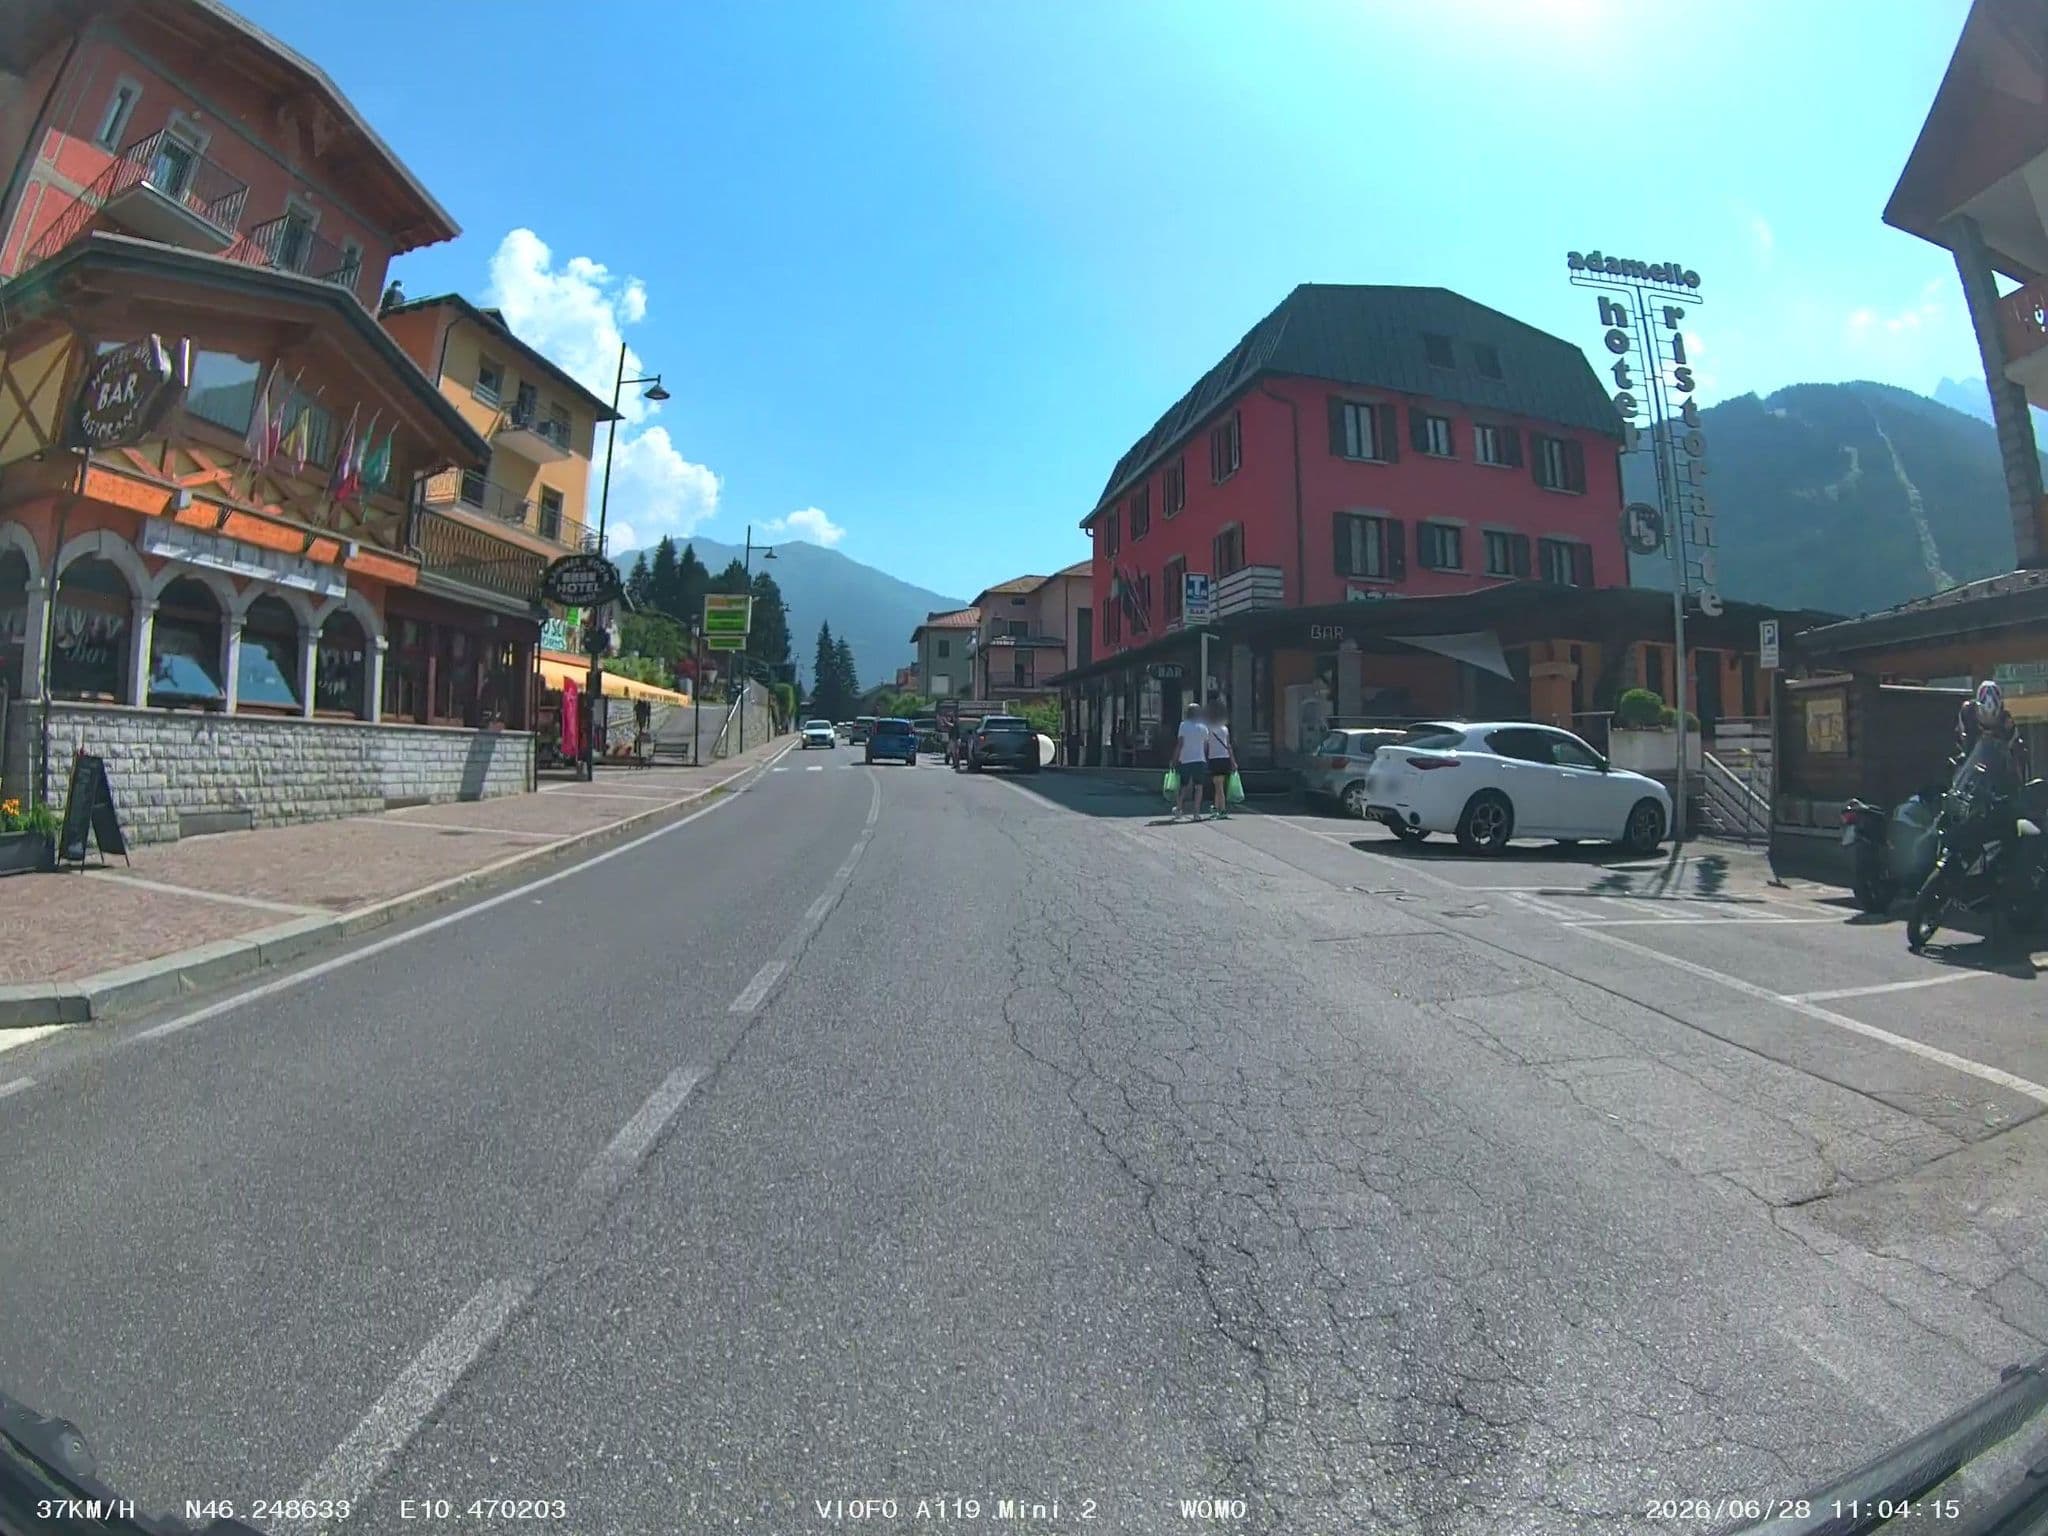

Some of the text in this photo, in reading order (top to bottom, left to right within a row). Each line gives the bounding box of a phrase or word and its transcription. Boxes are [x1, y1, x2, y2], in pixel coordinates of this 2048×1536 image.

[1567, 250, 1701, 289] adamello
[1597, 296, 1641, 453] hotel
[97, 372, 138, 412] BAR
[556, 583, 600, 594] HOTEL
[1311, 624, 1344, 640] BAR
[1764, 624, 1774, 645] P
